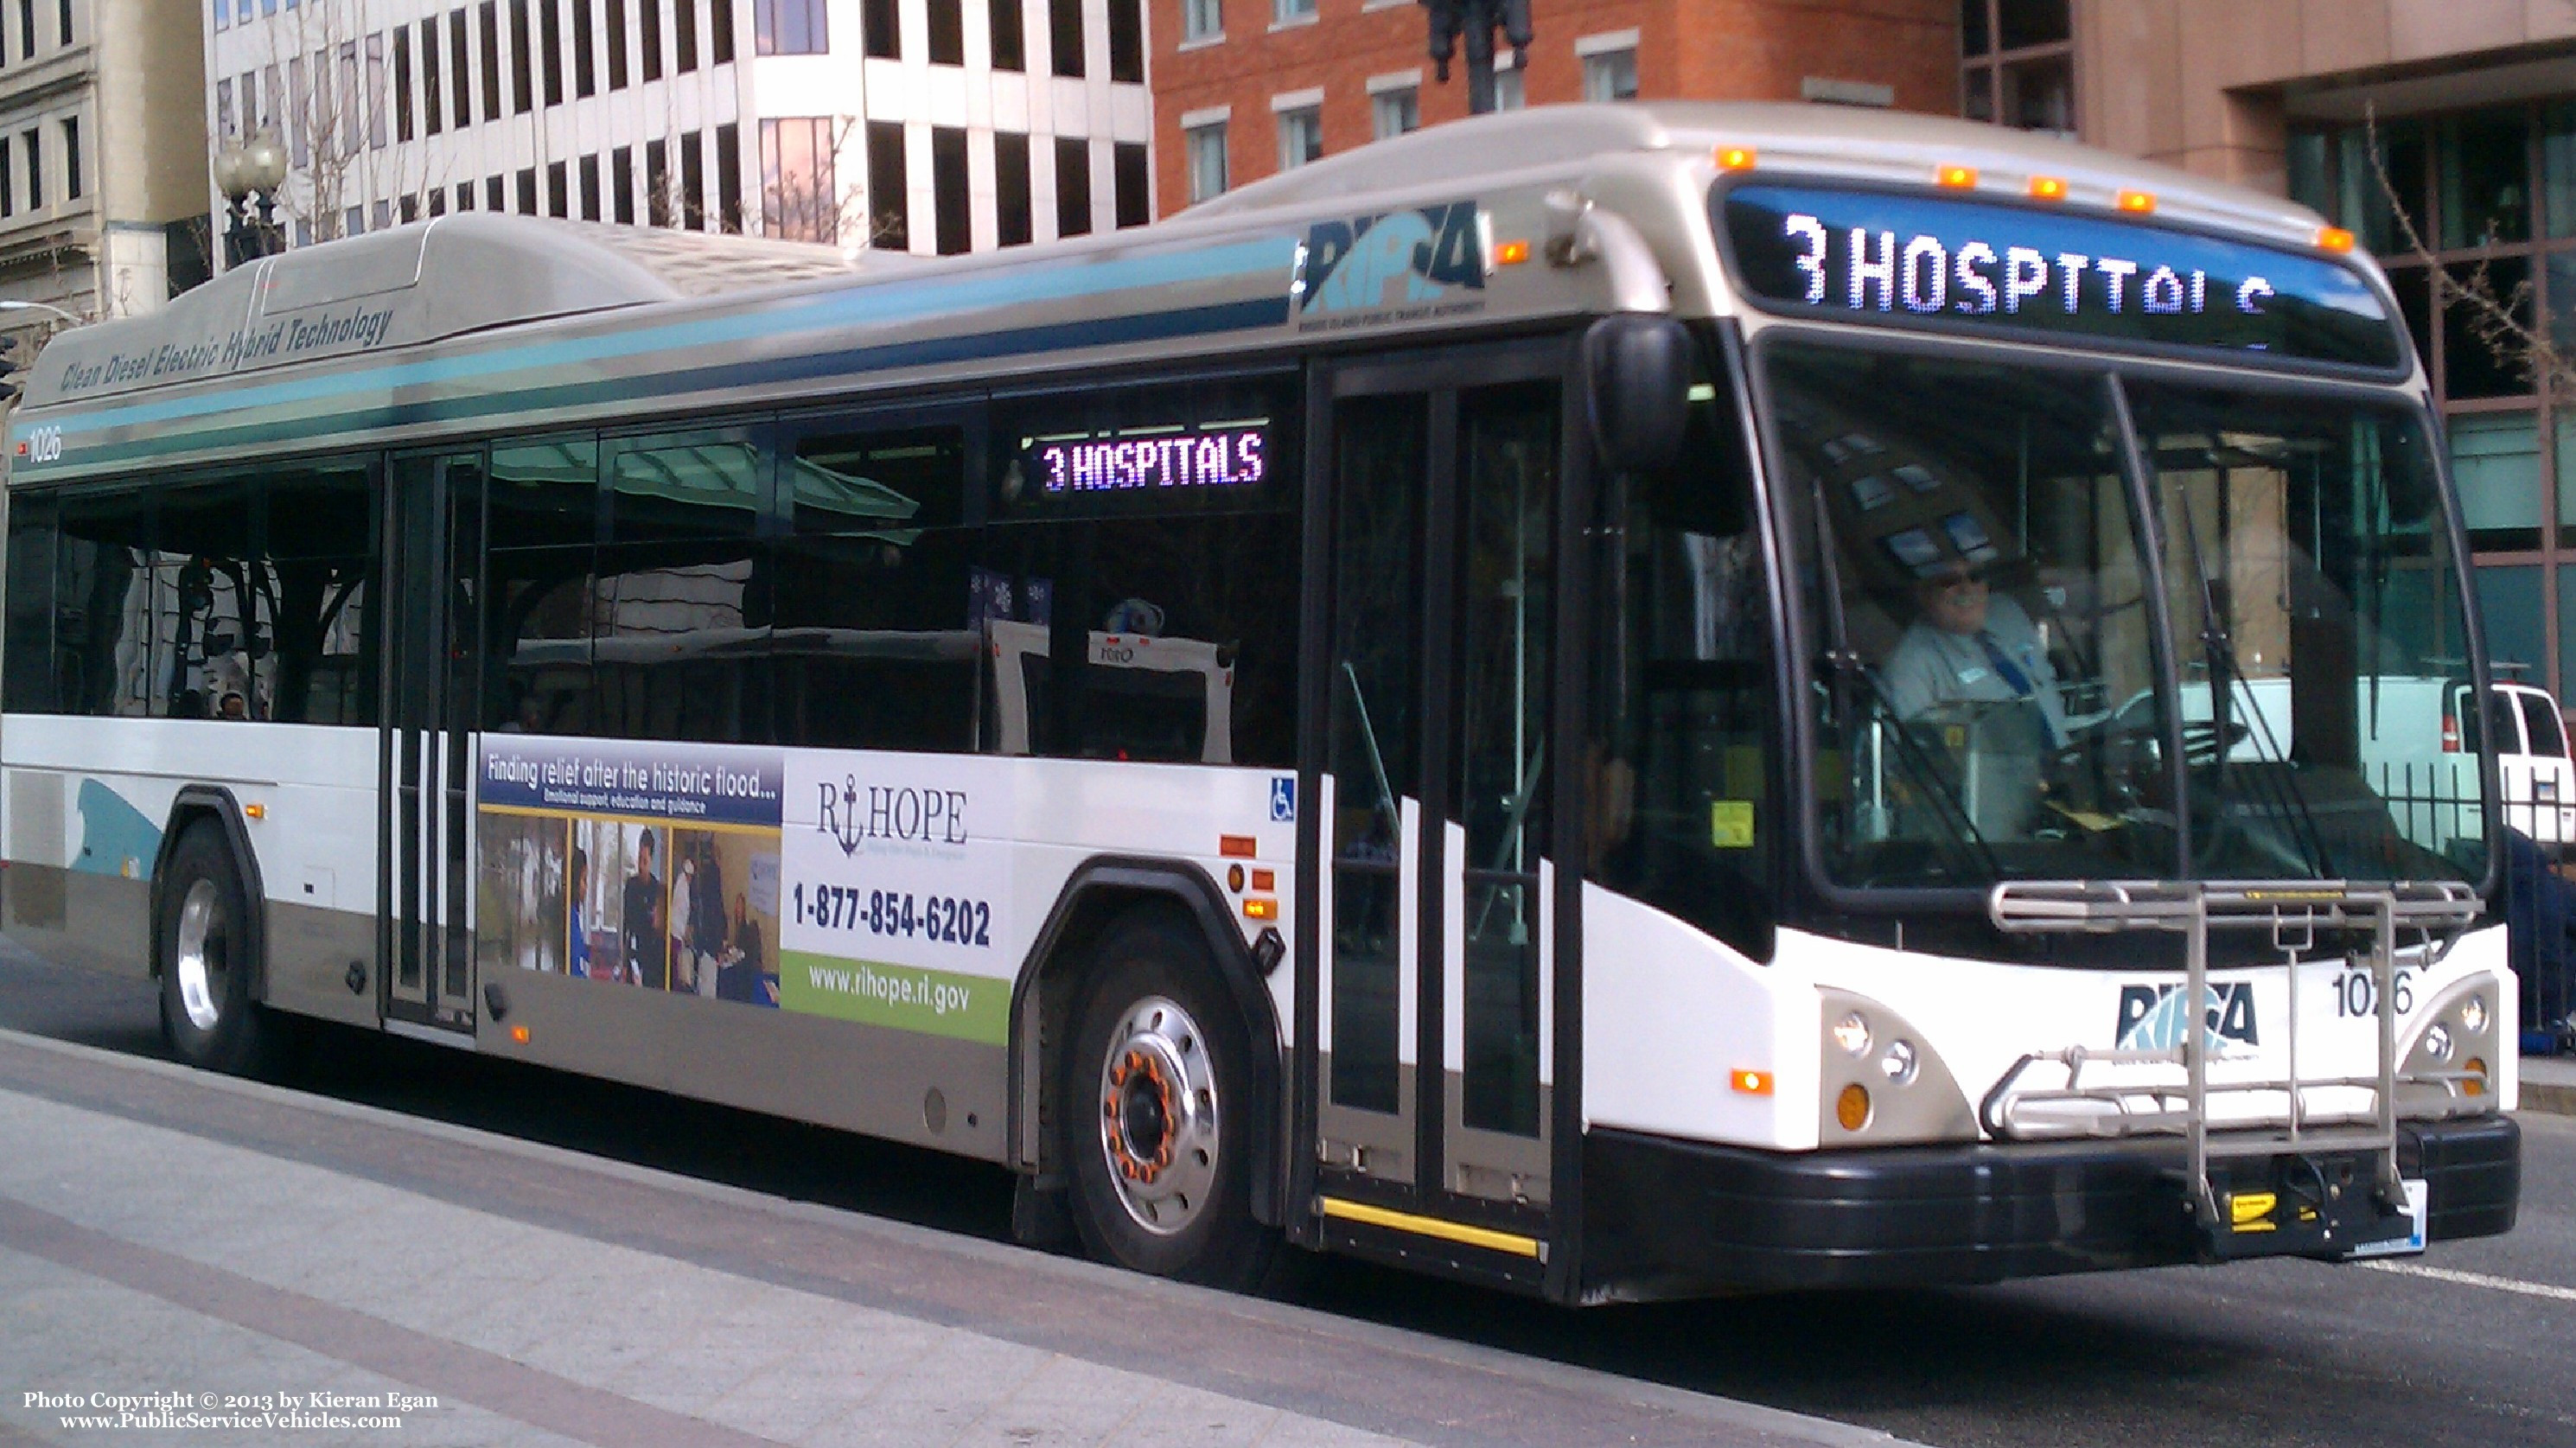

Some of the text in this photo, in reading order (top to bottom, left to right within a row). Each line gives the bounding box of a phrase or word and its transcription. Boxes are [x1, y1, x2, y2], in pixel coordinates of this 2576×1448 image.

[1301, 200, 1485, 314] RIPTA
[1786, 214, 1827, 305] 3
[61, 305, 394, 392] Clean Diesel Electric Hybrid Technology
[30, 424, 61, 463] 1026
[1043, 432, 1262, 492] 3 HOSPITALS
[488, 753, 776, 801] Finding relief after the historic flood...
[867, 786, 967, 845] HOPE
[794, 881, 992, 948] 1-877-854-6202
[809, 965, 970, 1015] www.rihope.ri.gov
[2332, 971, 2413, 1017] 106
